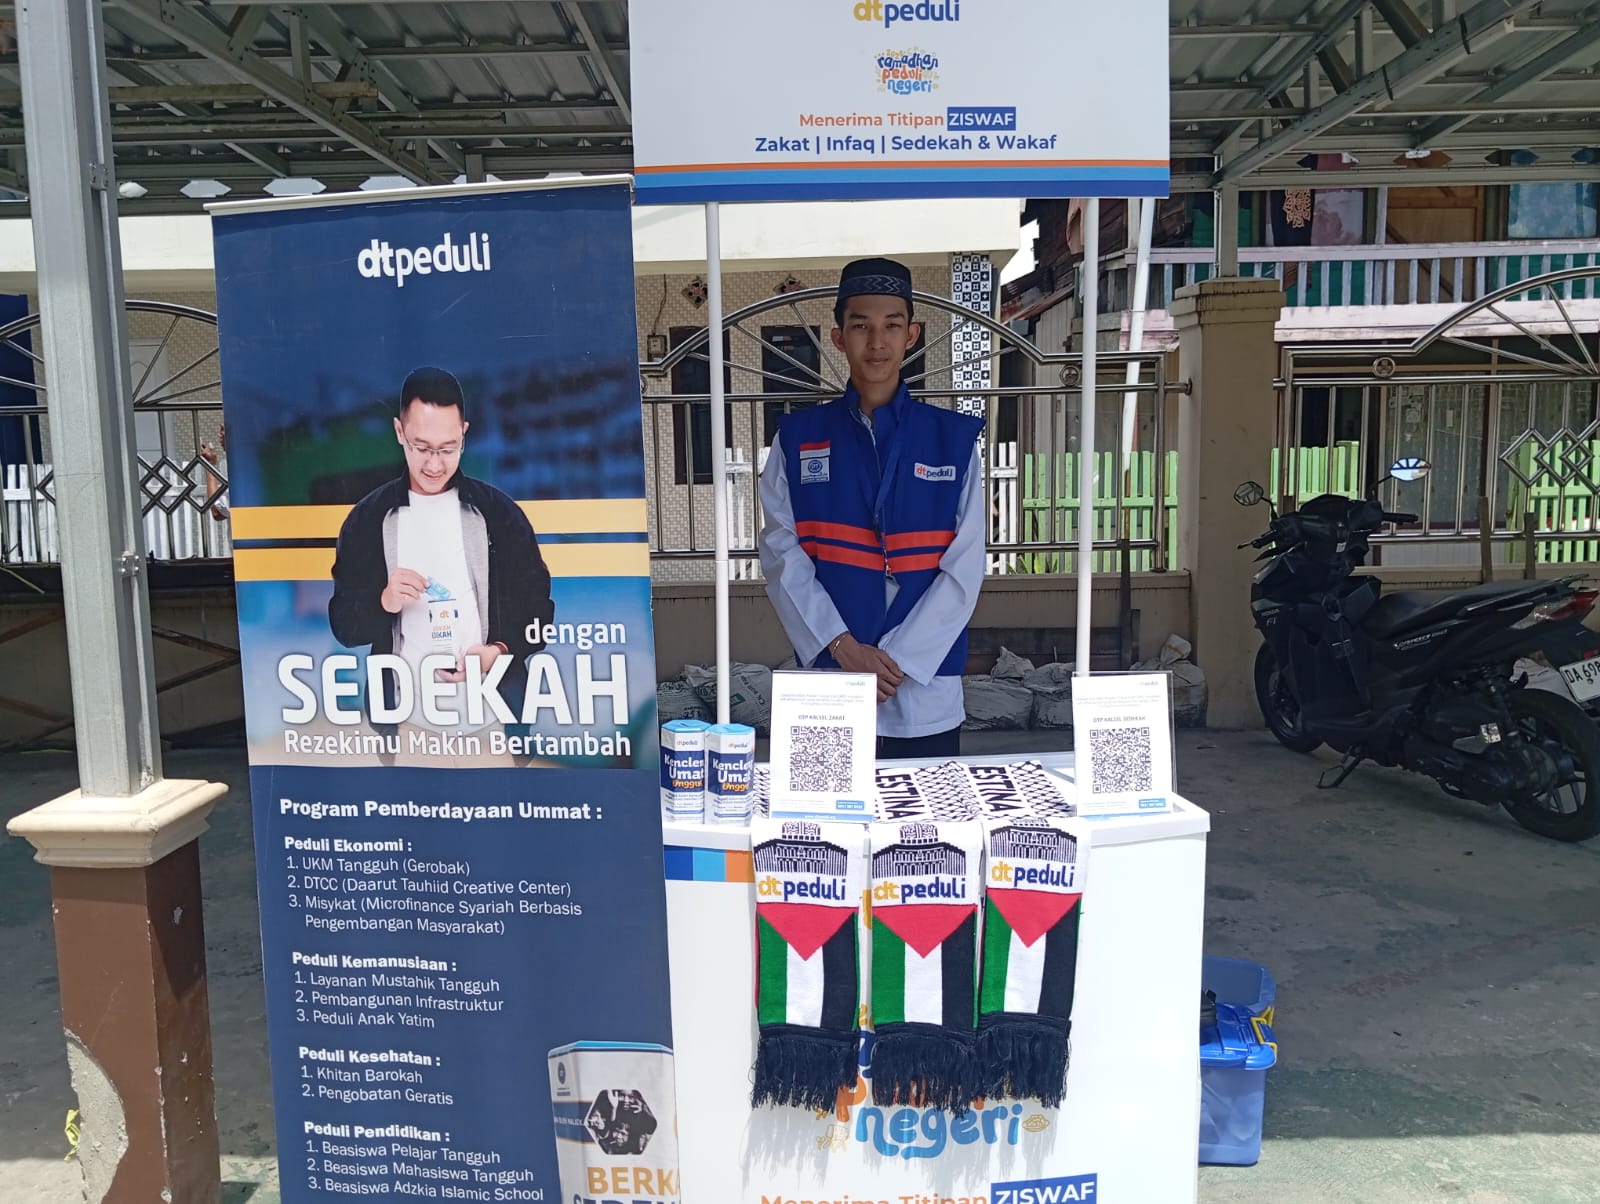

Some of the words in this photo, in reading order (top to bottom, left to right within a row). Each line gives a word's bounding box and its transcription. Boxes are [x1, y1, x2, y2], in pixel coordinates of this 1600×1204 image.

[853, 0, 961, 28] dtpeduli
[877, 52, 938, 71] ramadhan
[882, 65, 922, 84] peduli
[887, 79, 932, 95] negeri
[800, 113, 882, 126] Menerima
[887, 112, 943, 129] Titipan
[948, 111, 1014, 126] ZISWAF
[755, 136, 810, 151] Zakat
[827, 136, 874, 154] Infaq
[892, 135, 972, 150] Sedekah
[978, 136, 990, 149] &
[996, 135, 1057, 149] Wakaf
[358, 232, 490, 287] dtpeduli
[916, 466, 953, 478] dtpeduli
[525, 617, 627, 651] dengan
[1564, 667, 1583, 684] DA
[278, 653, 631, 726] SEDEKAH
[283, 727, 402, 756] Rezekimu
[408, 731, 482, 757] Makin
[489, 729, 633, 757] Bertambah
[280, 799, 358, 819] Program
[365, 801, 512, 822] Pemberdayaan
[519, 802, 591, 819] Ummat
[285, 836, 330, 851] Peduli
[334, 838, 403, 852] Ekonomi
[287, 856, 298, 869] 1.
[303, 857, 333, 871] UKM
[337, 858, 398, 874] Tangguh
[403, 859, 469, 876] (Gerobak)
[991, 861, 1075, 888] dtpeduli
[288, 875, 300, 888] 2.
[304, 876, 338, 890] DTCC
[343, 878, 397, 893] (Daarut
[401, 878, 448, 893] Tauhiid
[453, 881, 513, 894] Creative
[519, 880, 570, 898] Center)
[757, 874, 846, 901] dtpeduli
[873, 877, 966, 904] dtpeduli
[289, 894, 301, 907] 3.
[306, 896, 357, 912] Misykat
[361, 897, 454, 913] (Microfinance
[459, 900, 514, 916] Syariah
[520, 900, 582, 915] Berbasis
[306, 915, 413, 932] Pengembangan
[417, 918, 504, 935] Masyarakat)
[293, 952, 338, 967] Peduli
[342, 955, 447, 971] Kemanusiaan
[295, 971, 306, 983] 1.
[311, 972, 366, 988] Layanan
[372, 974, 435, 989] Mustahik
[439, 977, 499, 995] Tangguh
[296, 990, 308, 1003] 2.
[312, 991, 411, 1009] Pembangunan
[416, 995, 504, 1011] Infrastruktur
[297, 1009, 309, 1021] 3.
[313, 1010, 353, 1025] Peduli
[358, 1012, 395, 1025] Anak
[398, 1012, 434, 1028] Yatim
[299, 1046, 344, 1062] Peduli
[349, 1050, 432, 1065] Kesehatan
[301, 1065, 313, 1078] 1.
[317, 1067, 360, 1082] Khitan
[365, 1069, 422, 1083] Barokah
[302, 1084, 314, 1096] 2.
[319, 1085, 401, 1103] Pengobatan
[405, 1088, 453, 1104] Geratis
[304, 1121, 350, 1137] Peduli
[354, 1125, 441, 1141] Pendidikan
[855, 1102, 1024, 1161] negeri
[306, 1140, 318, 1152] 1.
[322, 1141, 387, 1157] Beasiswa
[392, 1143, 437, 1161] Pelajar
[441, 1148, 500, 1166] Tangguh
[307, 1158, 319, 1171] 2.
[324, 1160, 388, 1176] Beasiswa
[393, 1162, 469, 1181] Mahasiswa
[472, 1169, 533, 1185] Tangguh
[586, 1166, 680, 1196] BERK
[308, 1176, 321, 1189] 3.
[325, 1178, 389, 1194] Beasiswa
[394, 1181, 436, 1197] Adzkia
[441, 1185, 490, 1201] Islamic
[495, 1187, 543, 1200] School
